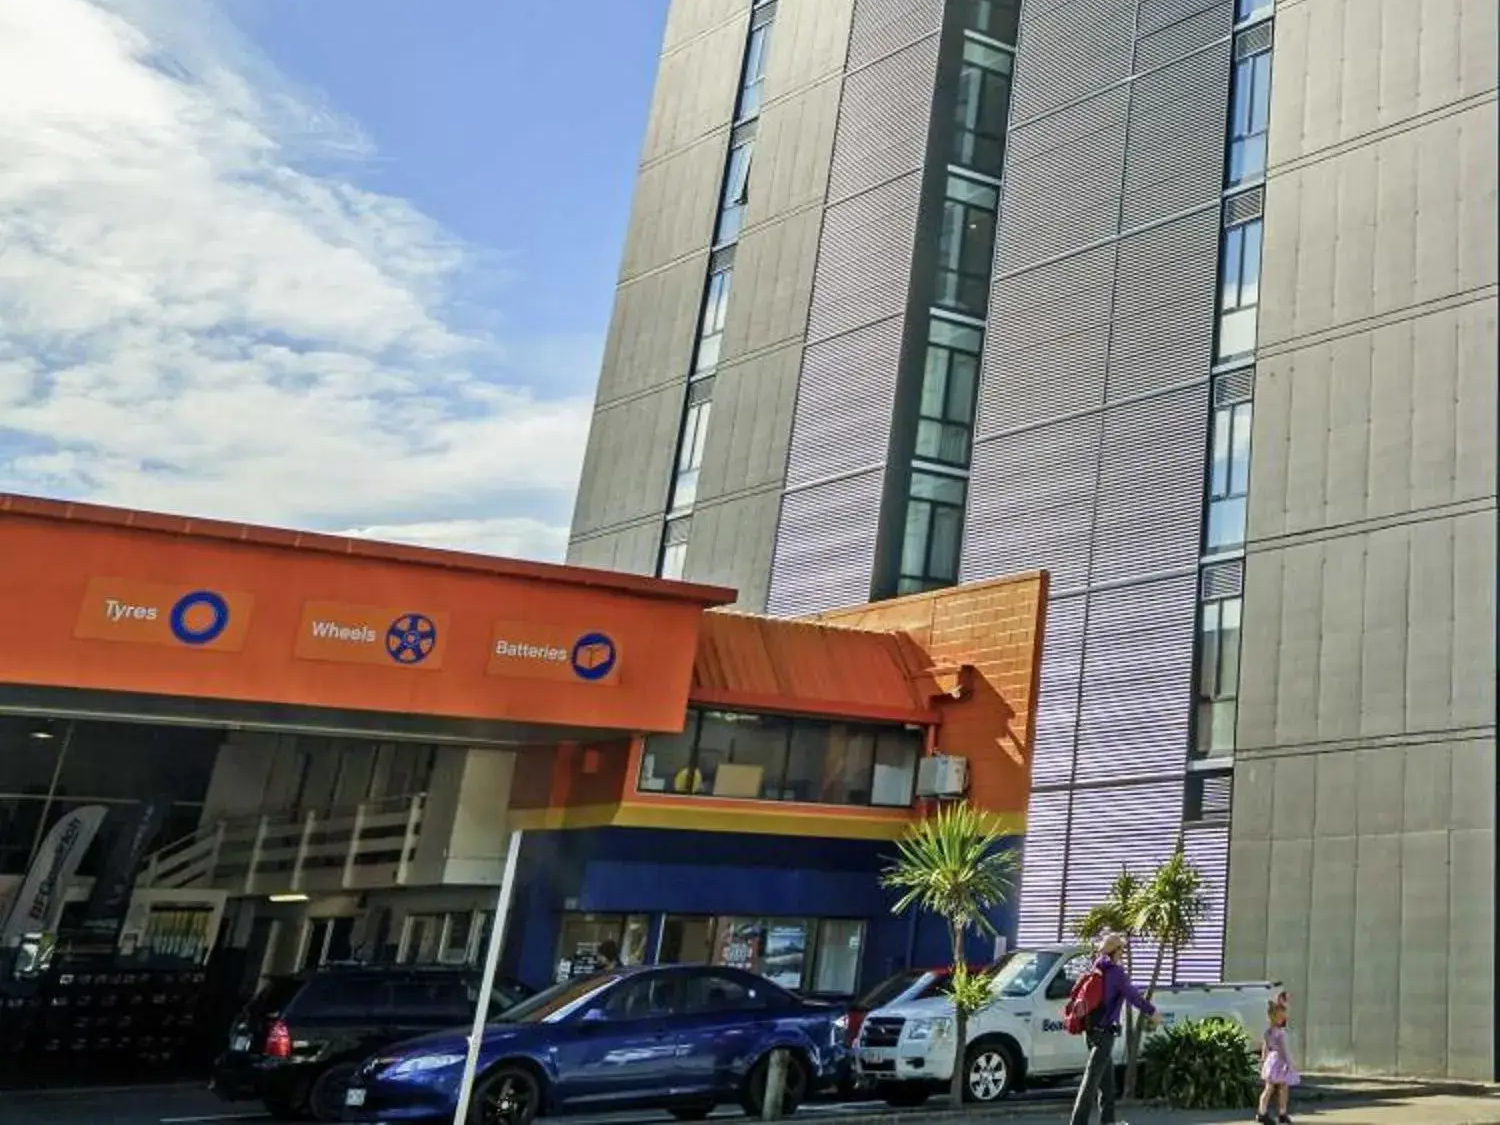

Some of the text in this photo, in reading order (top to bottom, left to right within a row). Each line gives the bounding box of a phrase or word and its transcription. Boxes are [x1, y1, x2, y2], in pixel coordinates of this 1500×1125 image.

[105, 599, 157, 621] Tyres
[311, 621, 377, 643] Wheels
[495, 639, 567, 661] Batteries
